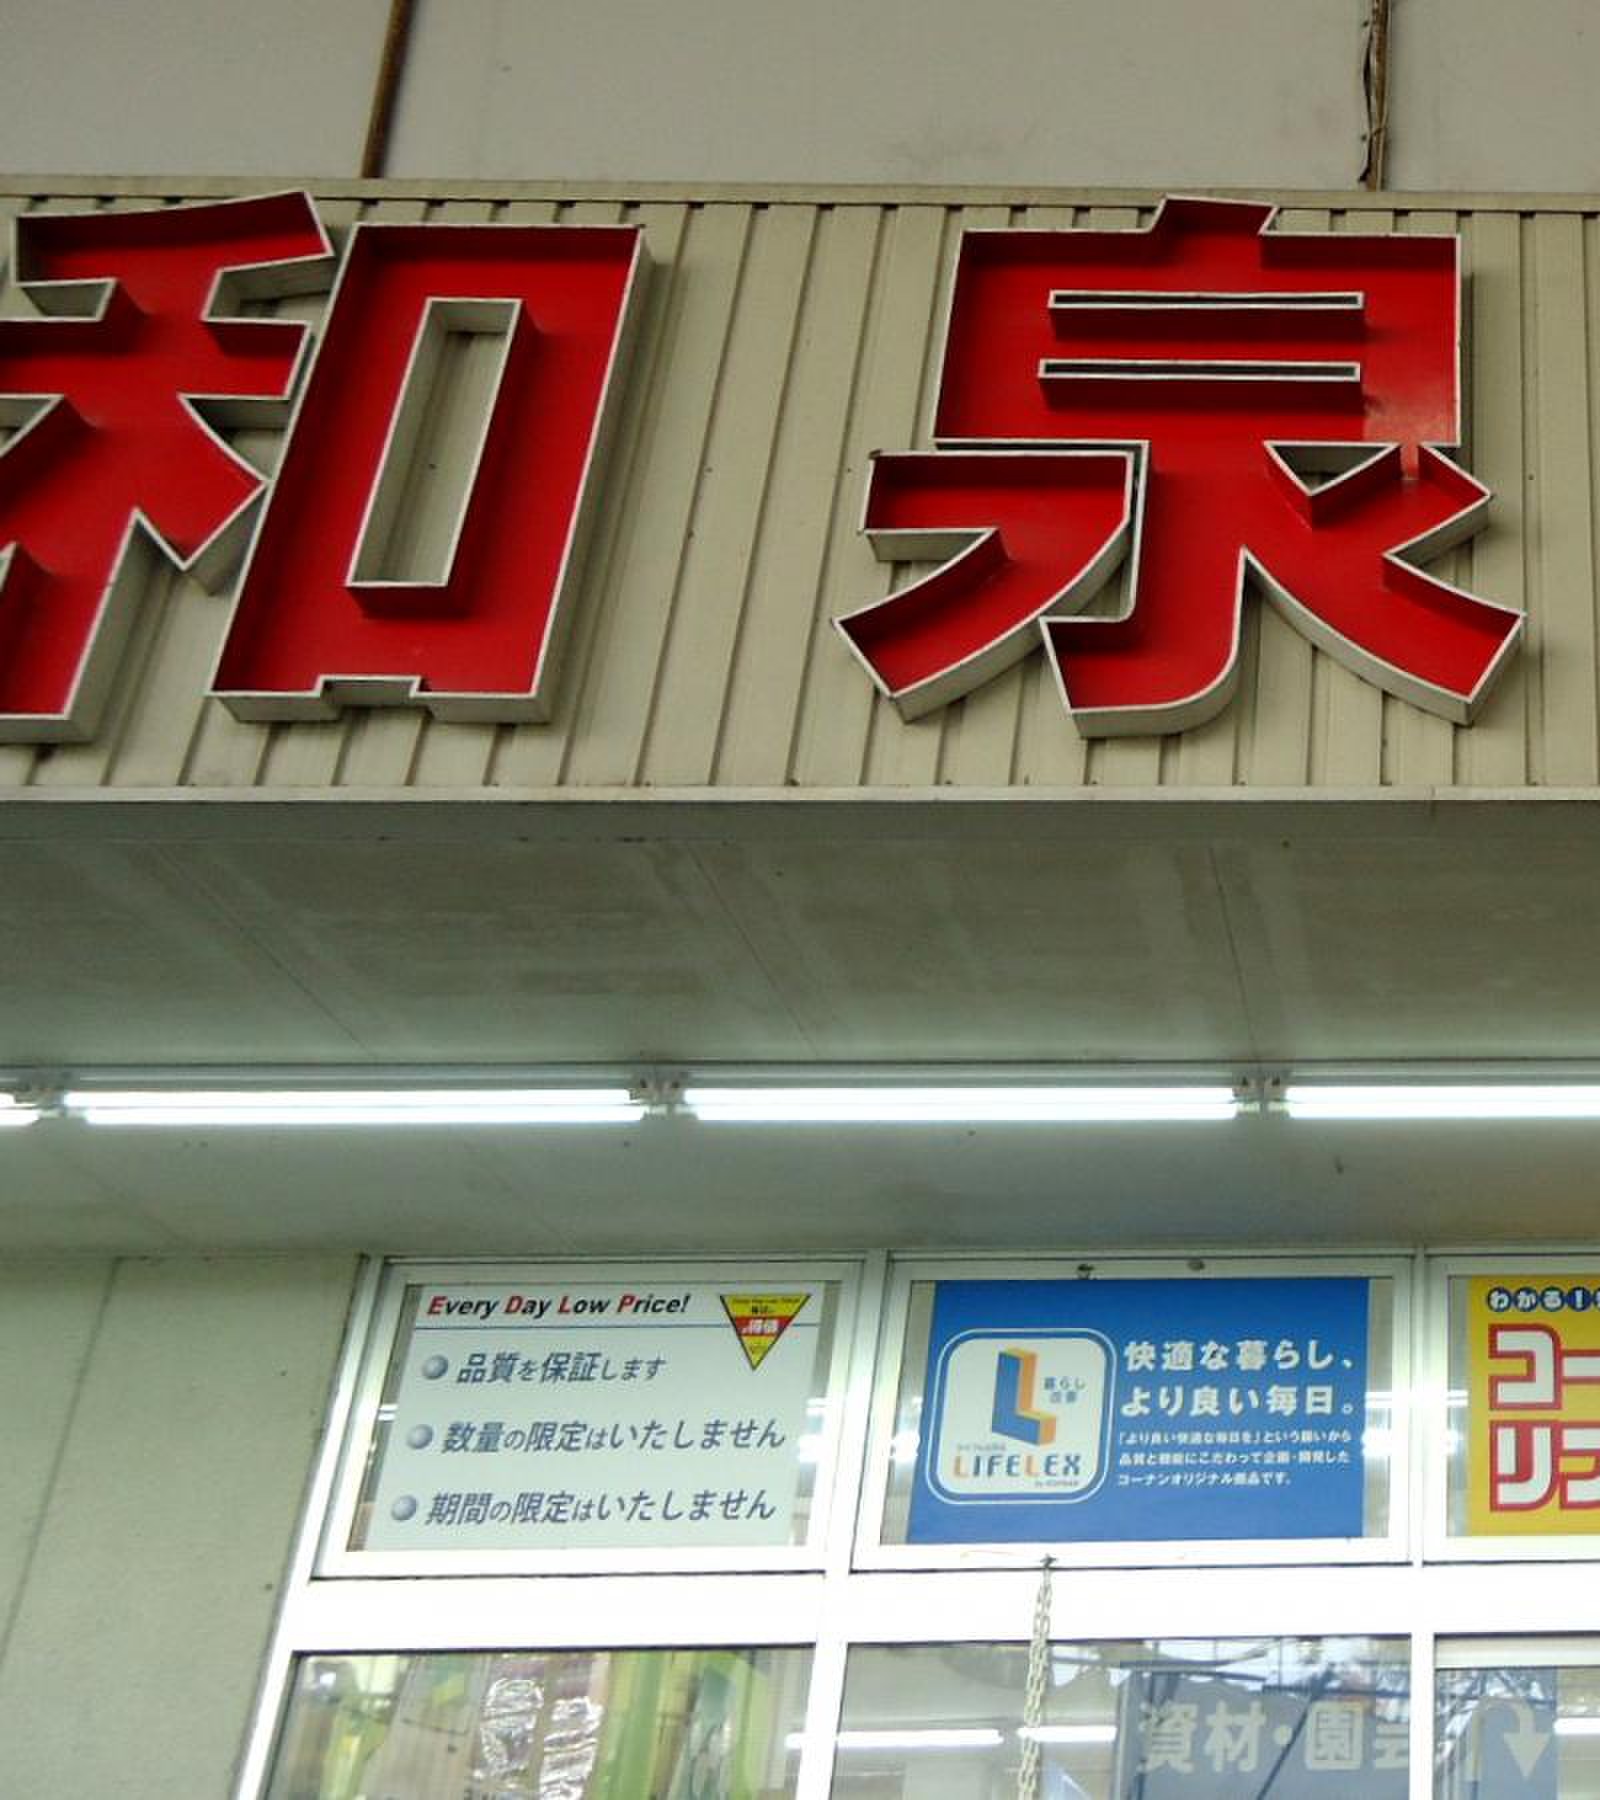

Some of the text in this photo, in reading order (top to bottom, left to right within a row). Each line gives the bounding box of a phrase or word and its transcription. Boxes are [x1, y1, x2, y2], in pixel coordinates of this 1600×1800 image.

[426, 1293, 691, 1320] Every Day Low Price!
[455, 1351, 667, 1384] 品質を保証します
[1124, 1339, 1354, 1372] 快適な暮らし、
[1120, 1385, 1354, 1418] より良い毎日。
[441, 1418, 785, 1454] 数量の限定はいたしません
[952, 1453, 1081, 1478] LIFELEX
[424, 1488, 777, 1526] 期間の限定はいたしません
